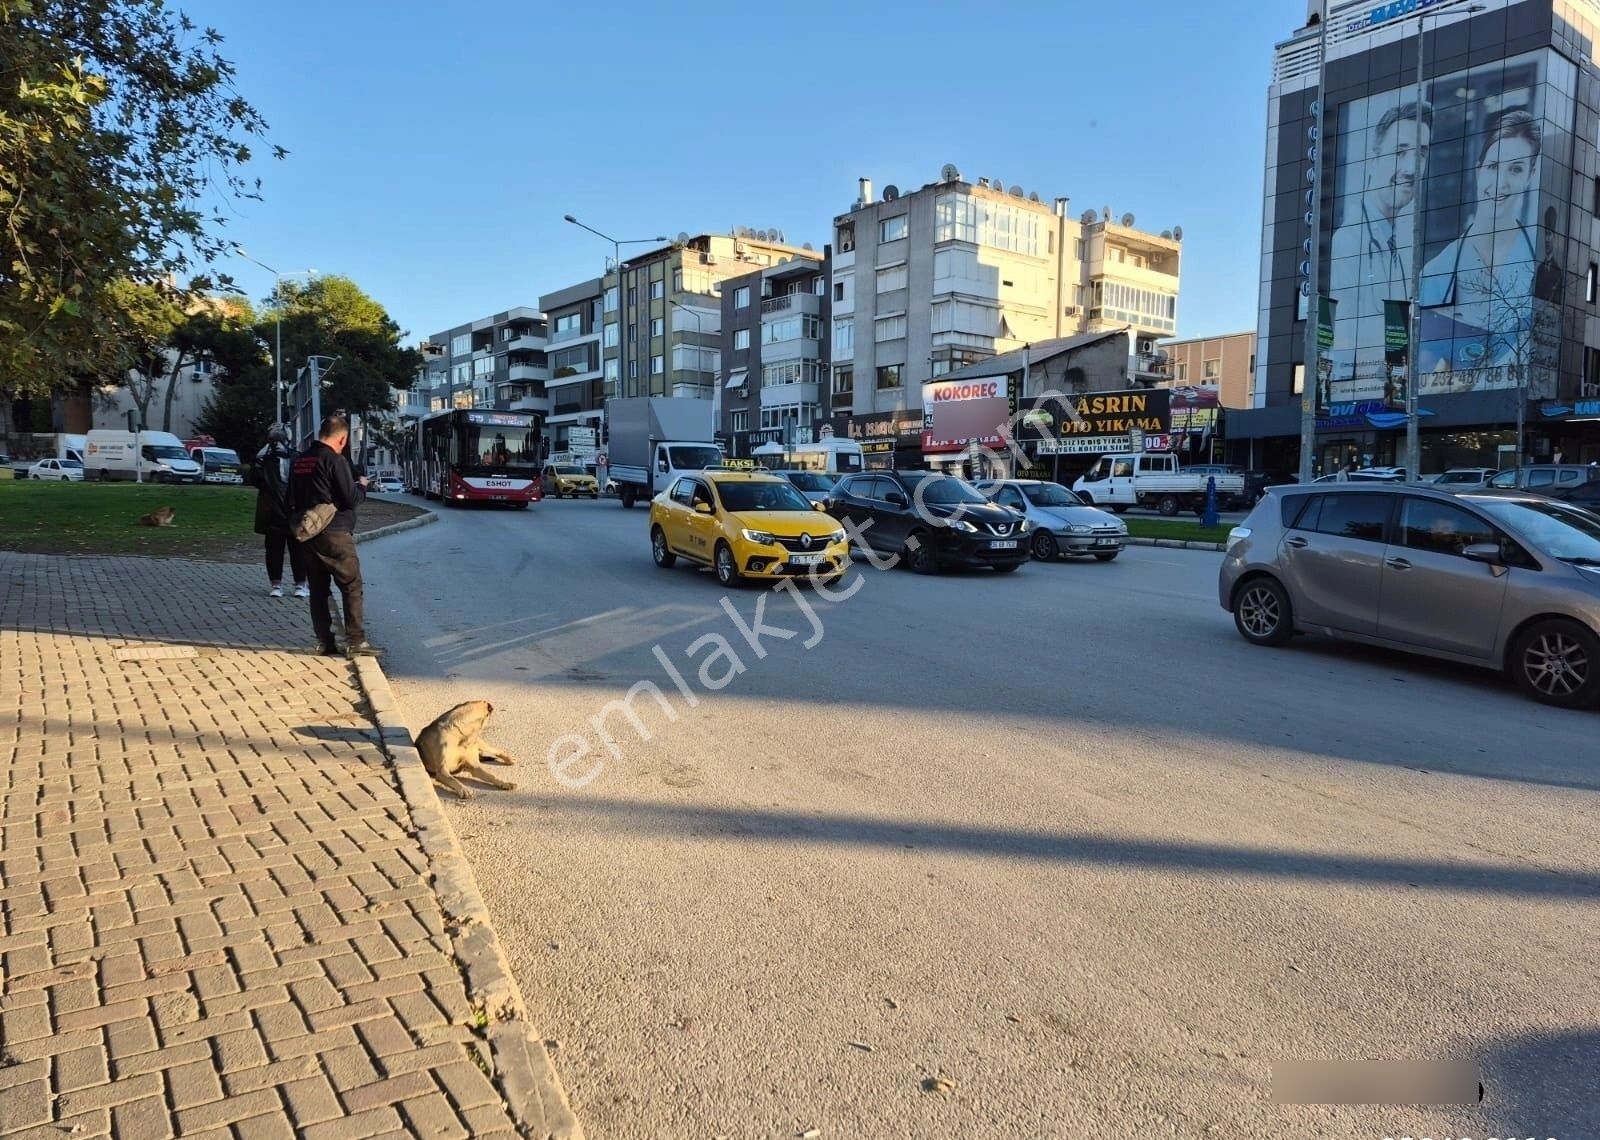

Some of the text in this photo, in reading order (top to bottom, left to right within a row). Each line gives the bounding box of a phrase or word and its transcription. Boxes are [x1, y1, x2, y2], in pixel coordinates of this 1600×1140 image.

[934, 382, 998, 401] KOKOREÇ
[1075, 394, 1147, 416] ASRIN
[1061, 421, 1092, 434] OTO
[1095, 417, 1162, 433] YIKAMA
[486, 480, 513, 488] ESHOT
